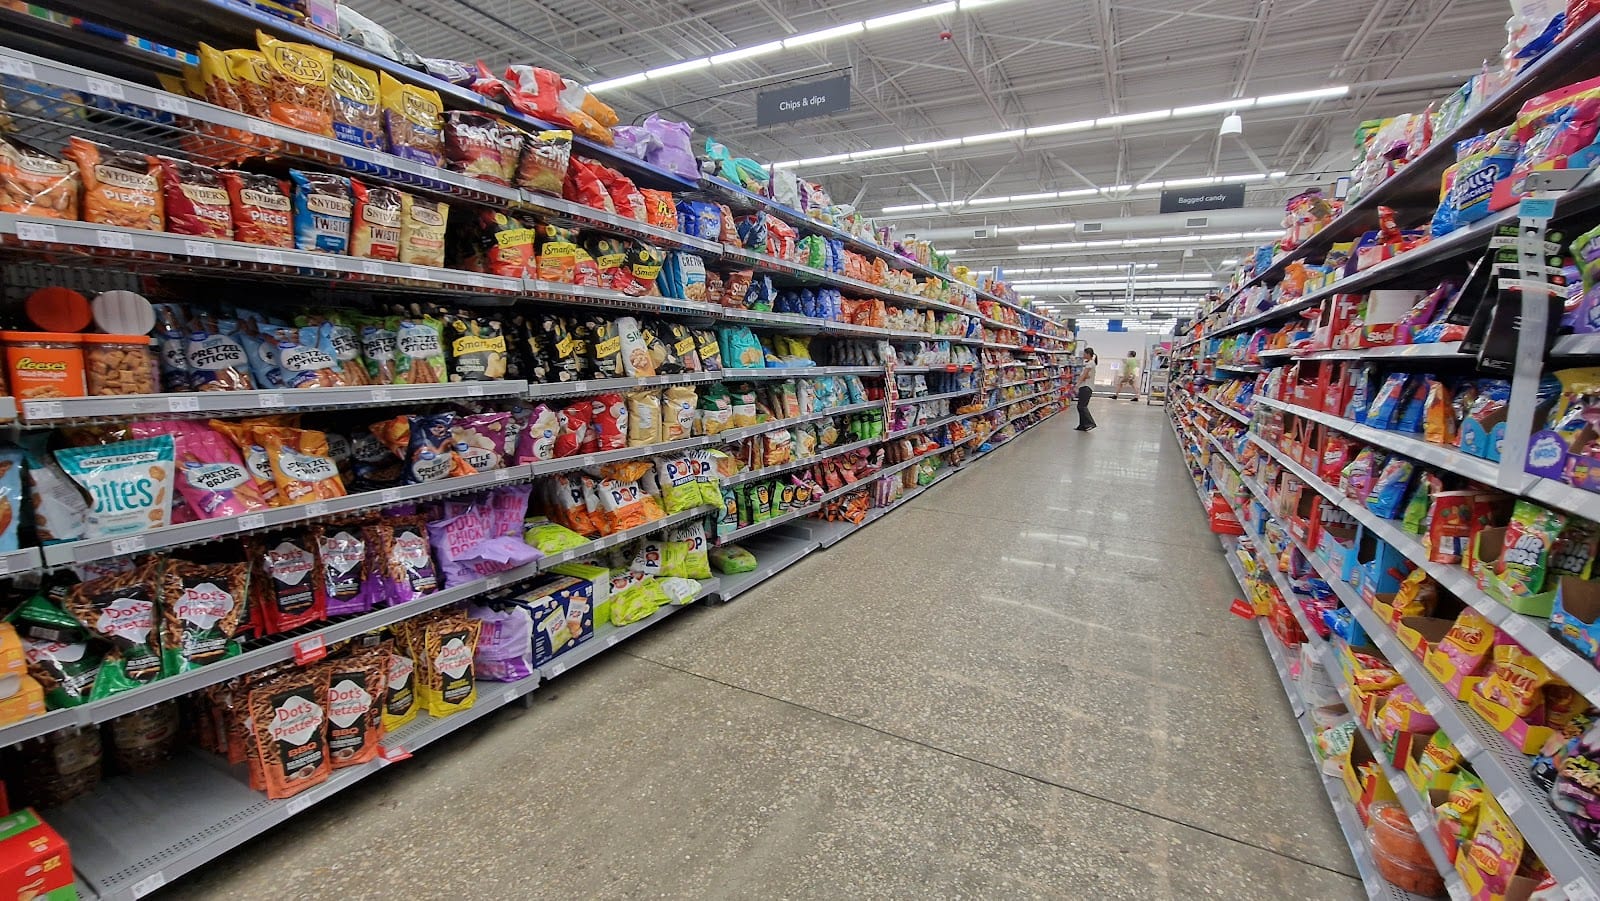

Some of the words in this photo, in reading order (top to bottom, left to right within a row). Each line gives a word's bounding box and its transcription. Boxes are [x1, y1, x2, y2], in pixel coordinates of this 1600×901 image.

[779, 101, 801, 111] Chips
[802, 97, 809, 107] &
[810, 95, 826, 106] dips
[1178, 195, 1204, 205] Bagged
[1205, 193, 1226, 202] candy
[251, 210, 289, 225] PIECES
[190, 344, 242, 361] PRETZEL
[403, 343, 438, 352] STICKS
[457, 339, 503, 352] Smartod
[196, 352, 241, 367] STICKS
[465, 453, 491, 464] TTLE
[196, 465, 239, 483] PRETZEL
[690, 459, 711, 476] OP
[206, 471, 243, 488] BRAIDS
[82, 478, 153, 514] bites
[612, 486, 638, 505] POP
[447, 527, 484, 546] CHICK
[684, 536, 703, 552] OP
[186, 587, 227, 601] Dot's
[105, 602, 153, 619] Dot's
[328, 687, 362, 702] Dot's
[277, 702, 313, 722] Dot's
[329, 703, 368, 717] retzels
[273, 716, 321, 739] Pretzels
[331, 727, 359, 737] BBQ
[288, 741, 318, 757] BBQ
